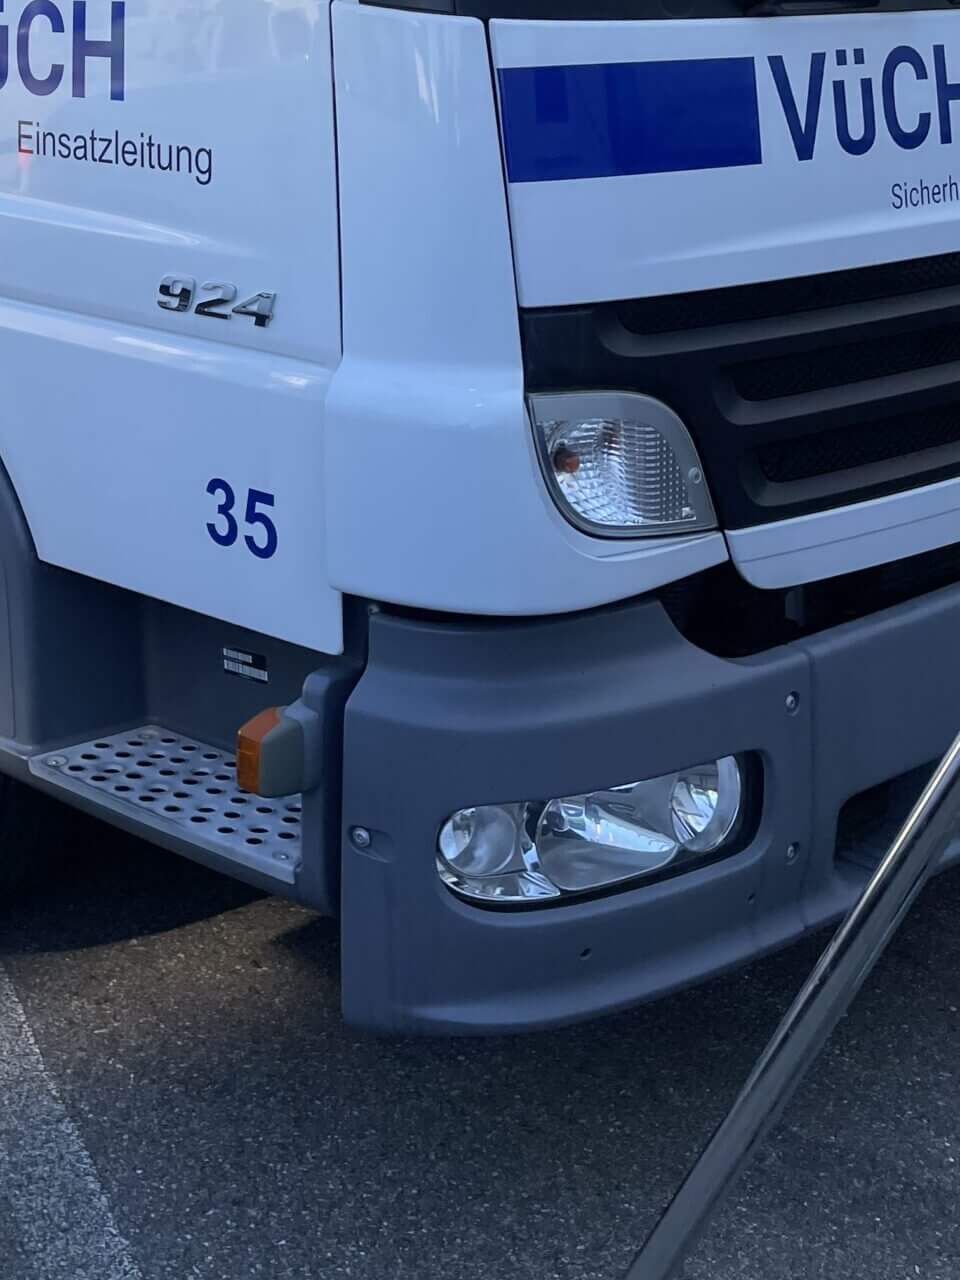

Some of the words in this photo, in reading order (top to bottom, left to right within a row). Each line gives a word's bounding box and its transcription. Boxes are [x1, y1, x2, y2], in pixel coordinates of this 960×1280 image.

[17, 120, 213, 186] Einsatzleitung
[891, 175, 959, 209] Sicherh
[156, 273, 278, 328] 924
[206, 477, 278, 559] 35
